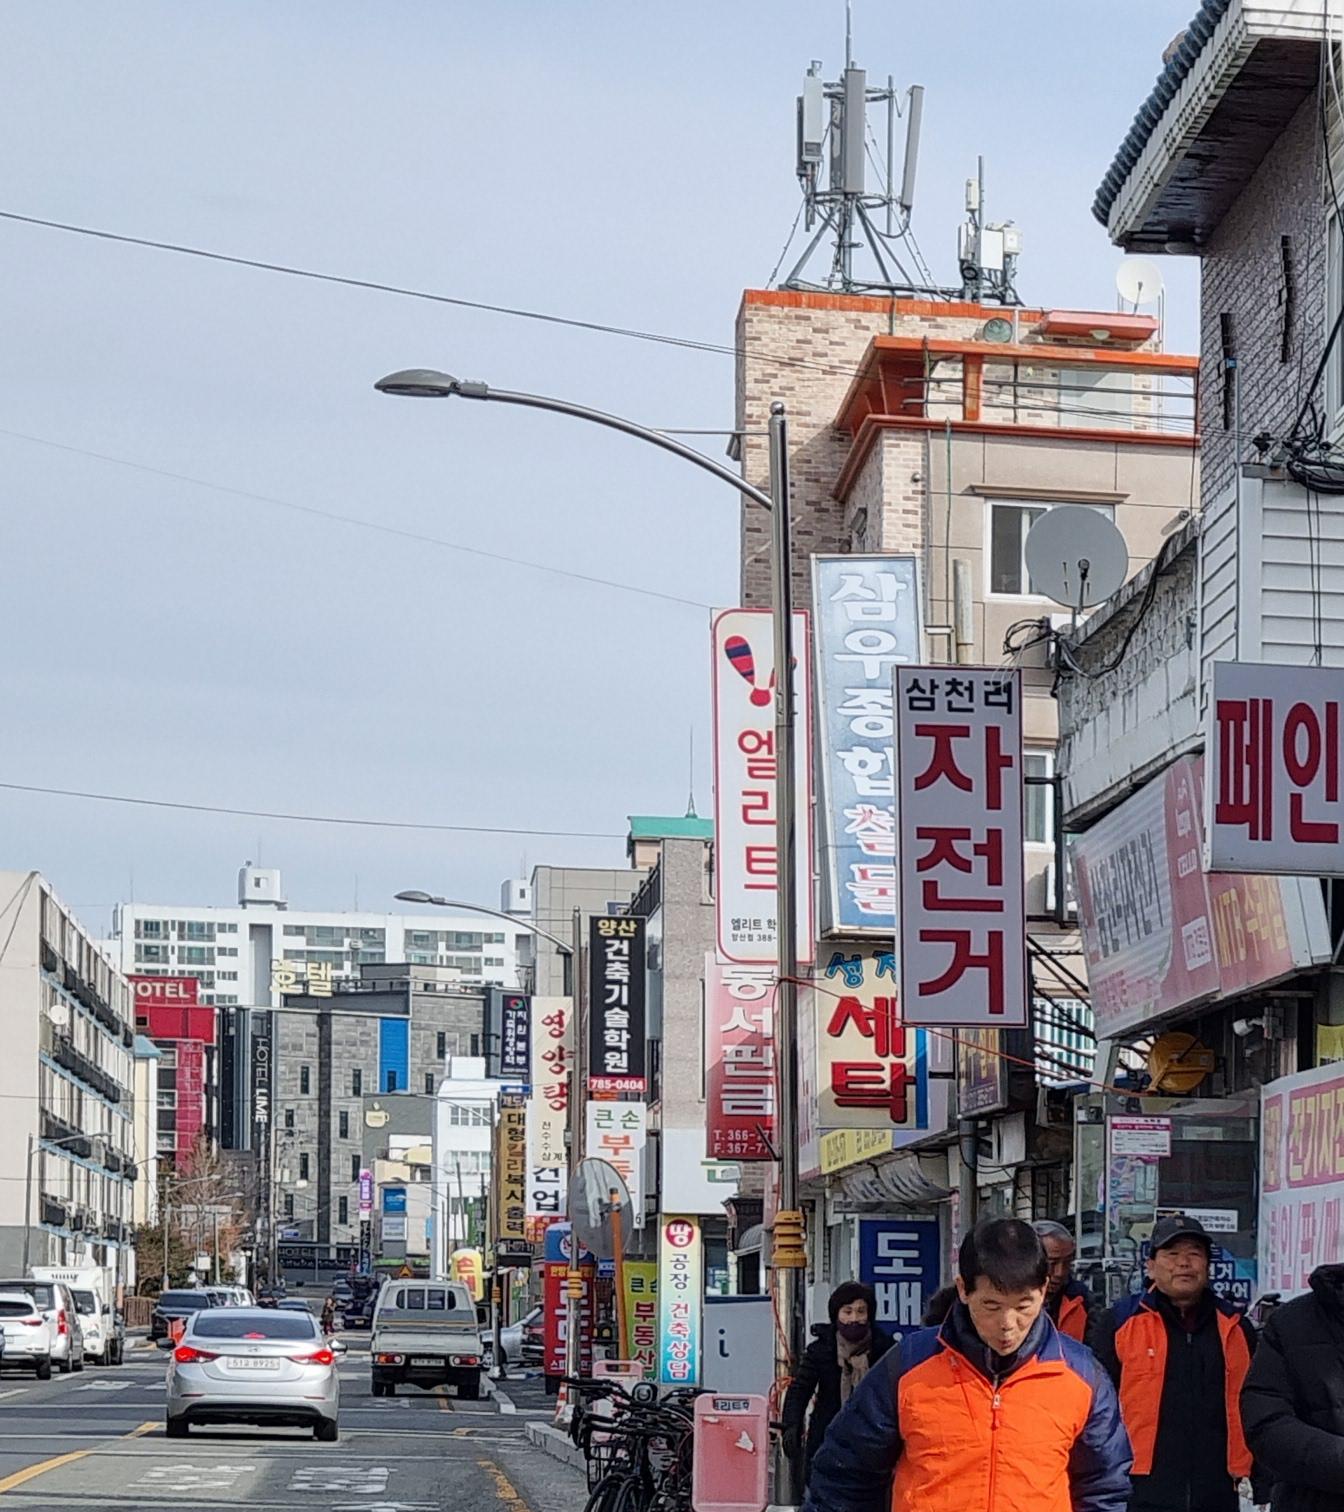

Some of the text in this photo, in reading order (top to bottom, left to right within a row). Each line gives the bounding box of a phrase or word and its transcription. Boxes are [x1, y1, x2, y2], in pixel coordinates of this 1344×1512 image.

[904, 677, 1014, 716] 삼천리
[914, 723, 1014, 1015] 자전거
[598, 919, 637, 937] 양산
[131, 980, 192, 999] OTEL
[604, 939, 632, 1074] 건축기술학원
[590, 1078, 644, 1092] 785-0404
[827, 995, 917, 1124] 세탁
[873, 1231, 923, 1326] 도배
